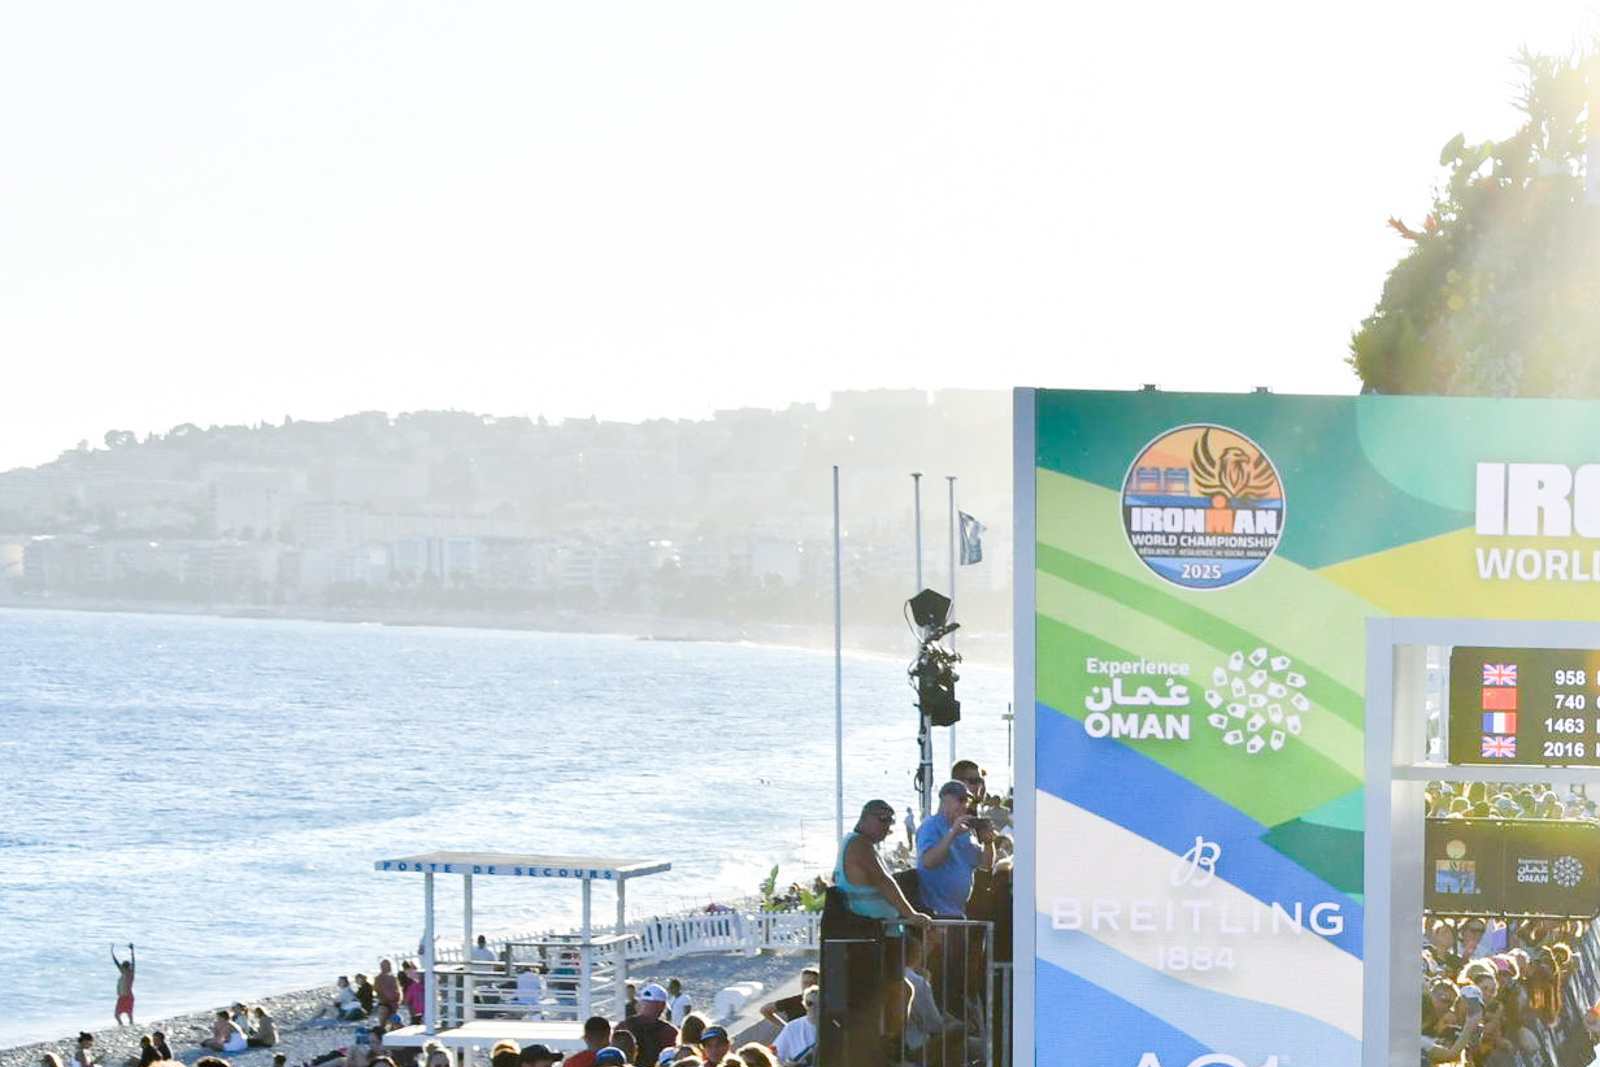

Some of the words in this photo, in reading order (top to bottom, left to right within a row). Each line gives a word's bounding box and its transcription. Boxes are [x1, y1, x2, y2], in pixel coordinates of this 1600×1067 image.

[1131, 507, 1277, 534] IRONMAN
[1132, 534, 1177, 547] WORLD
[1179, 535, 1279, 548] CHAMPIONSHIP
[1181, 563, 1222, 579] 2025
[1086, 657, 1190, 677] Experience
[1554, 670, 1586, 686] 958
[1554, 695, 1586, 710] 740
[1084, 712, 1190, 740] OMAN
[1544, 718, 1585, 734] 1463
[1543, 742, 1585, 758] 2016
[382, 861, 452, 873] POSTE
[473, 865, 497, 875] DE
[514, 867, 613, 880] SECOURS
[1051, 900, 1345, 937] BREITLING
[1156, 944, 1236, 972] 1884
